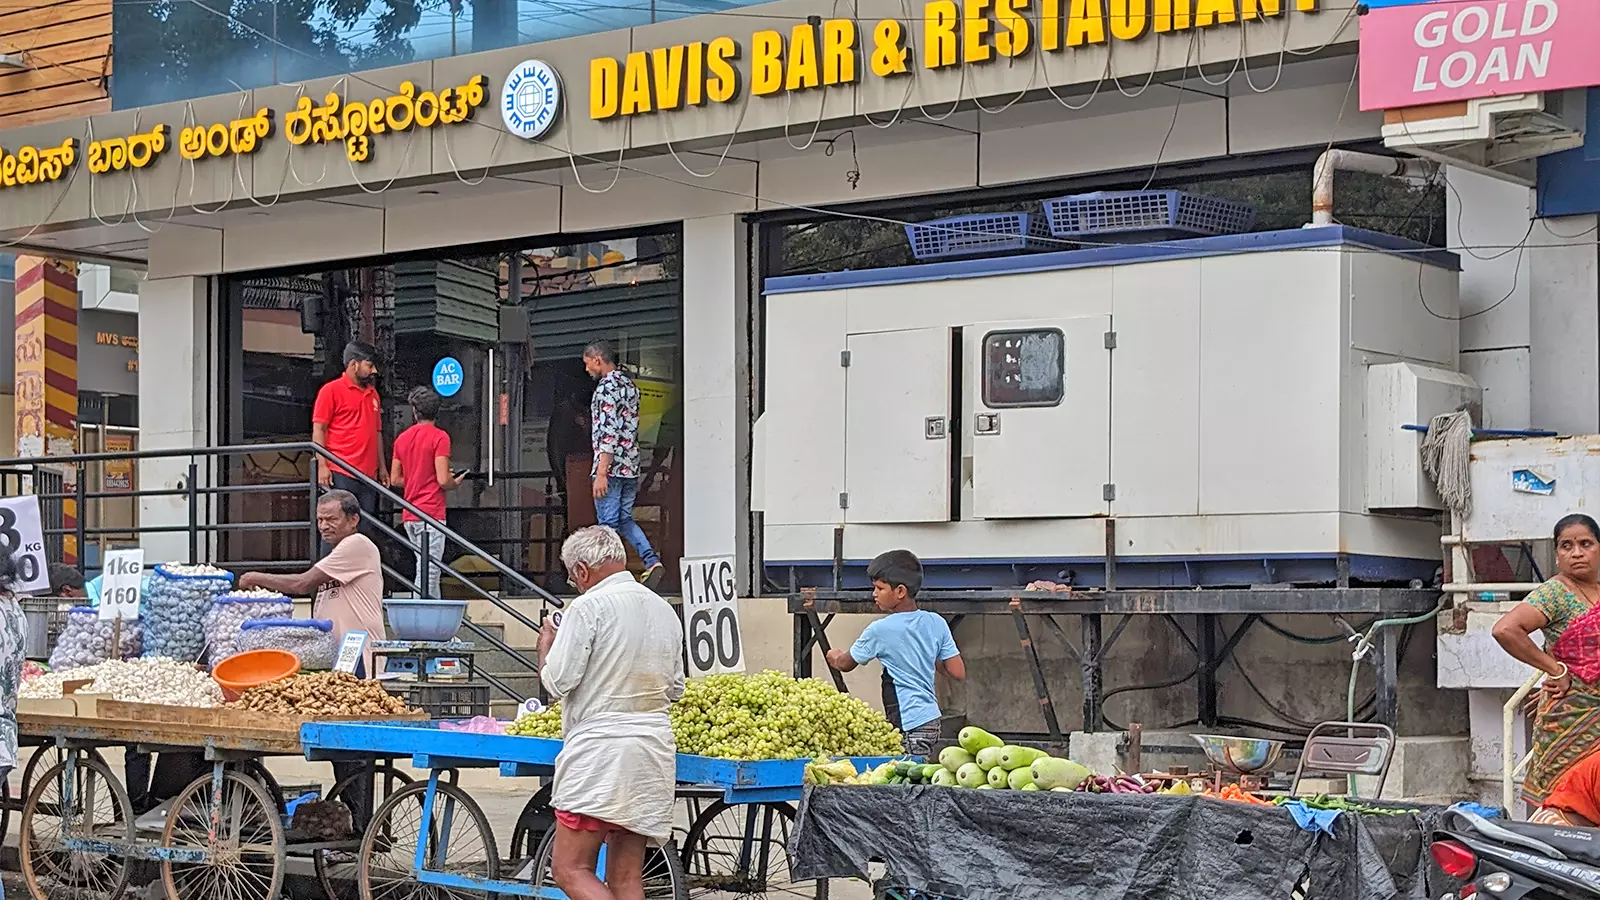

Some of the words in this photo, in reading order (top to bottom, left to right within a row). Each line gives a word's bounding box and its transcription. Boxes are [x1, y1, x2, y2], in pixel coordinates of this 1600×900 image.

[1413, 0, 1559, 48] GOLD
[589, 36, 736, 119] DAVIS
[749, 17, 856, 96] BAR
[870, 18, 908, 77] &
[923, 0, 1315, 69] RESTAU
[1412, 40, 1553, 93] LOAN
[87, 124, 166, 174] ಬಾರ್
[178, 107, 271, 160] ಅಂಡ್
[284, 75, 484, 162] ರೆಸ್ಟೋರೆಂಟ್
[96, 332, 119, 345] MVS
[436, 373, 461, 386] BAR
[440, 363, 456, 374] AC
[25, 542, 42, 552] KG
[104, 587, 137, 605] 160
[684, 561, 734, 605] 1.KG
[689, 607, 741, 672] 60
[1553, 832, 1593, 841] PLATINA
